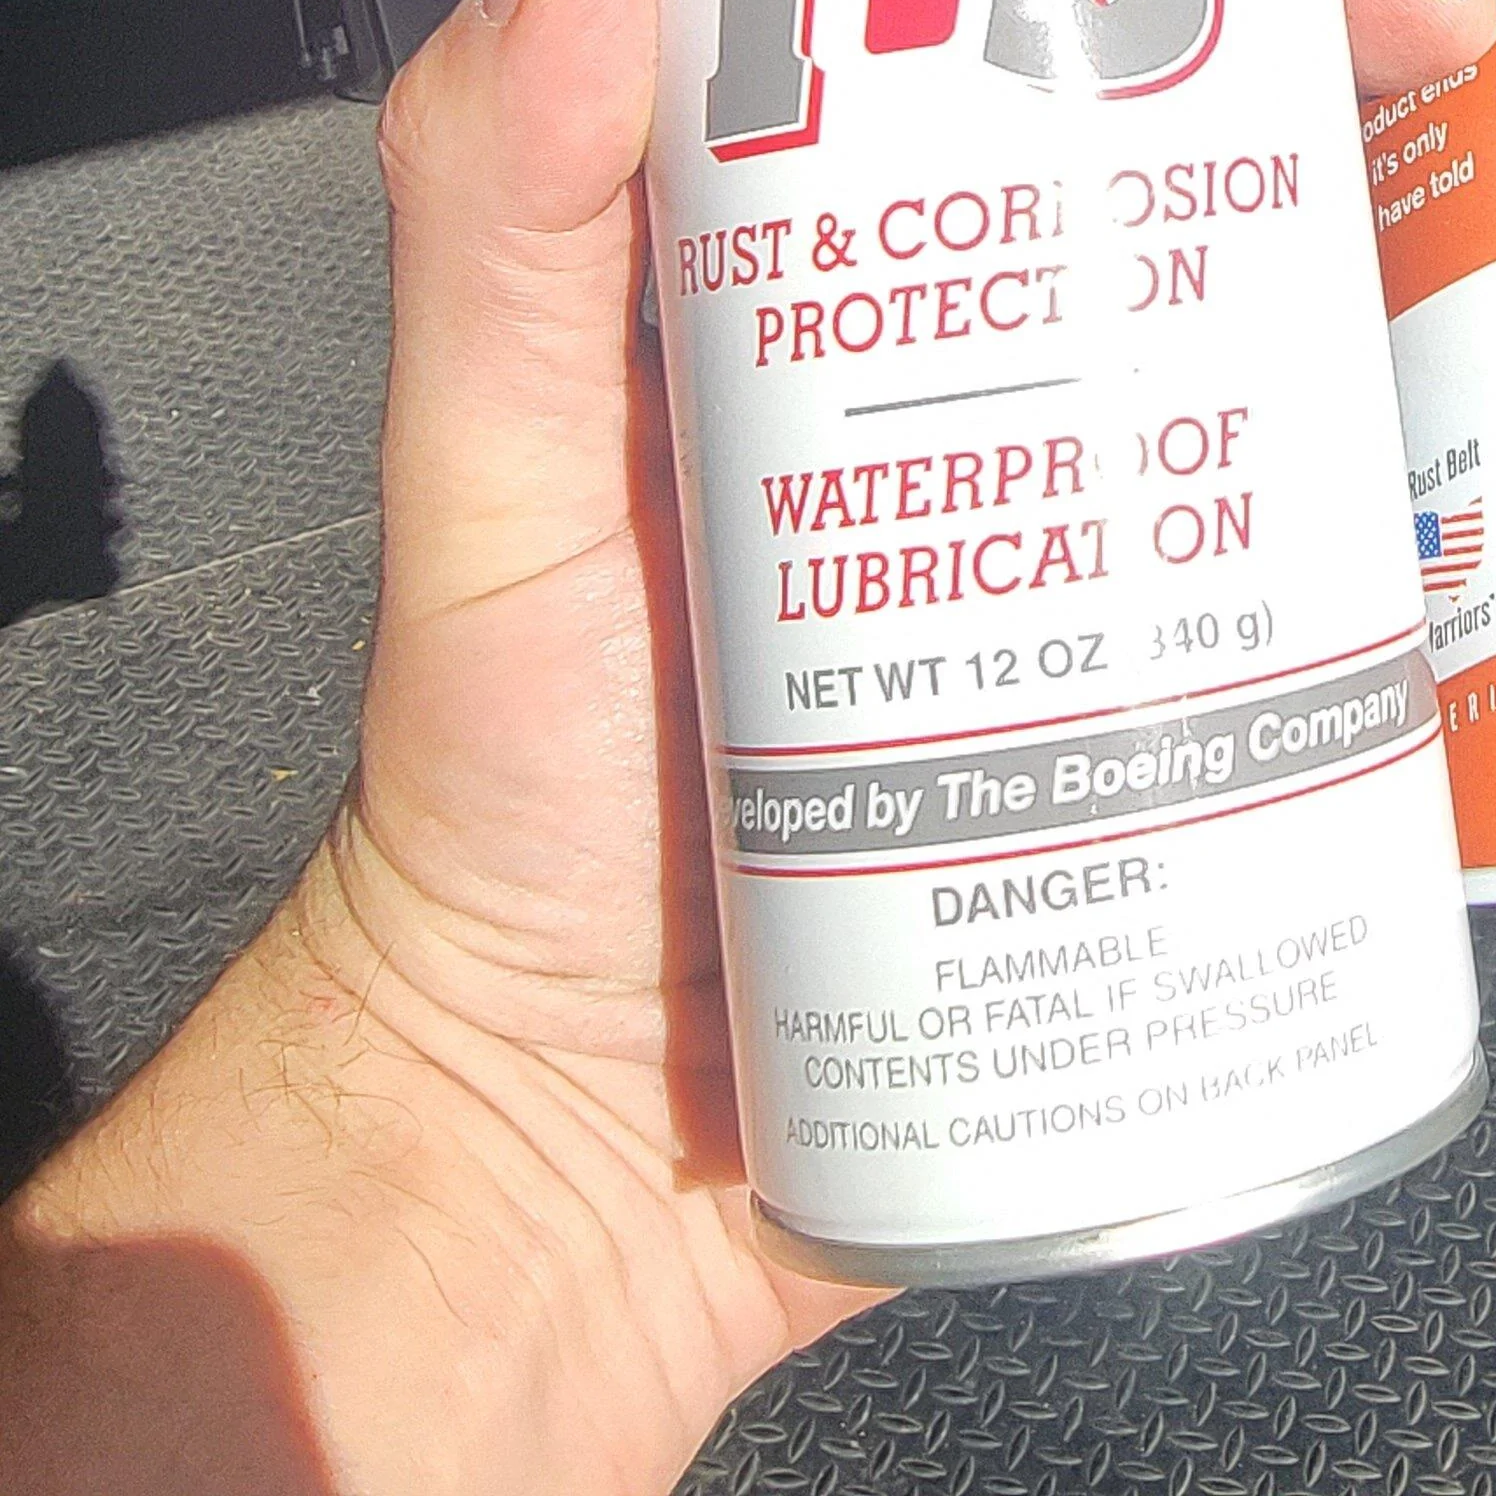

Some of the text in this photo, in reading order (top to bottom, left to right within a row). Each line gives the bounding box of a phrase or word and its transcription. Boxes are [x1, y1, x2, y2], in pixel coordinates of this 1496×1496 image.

[1378, 150, 1476, 233] have told
[1403, 120, 1448, 166] only
[676, 153, 1300, 297] RUST & COROSION
[754, 244, 1209, 369] PROTECTON
[761, 407, 1249, 537] WATERPROF
[1408, 437, 1481, 502] Rust Belt
[775, 491, 1254, 623] LUBRICATON
[785, 665, 864, 713] NET
[874, 656, 947, 703] WT
[966, 650, 1021, 688] 12
[1038, 631, 1108, 680] OZ
[1235, 599, 1274, 651] g)
[867, 780, 925, 836] by
[936, 767, 1037, 823] The
[1051, 727, 1237, 807] Boeing
[1246, 678, 1411, 764] Company
[931, 855, 1171, 929] DANGER:
[774, 914, 1369, 1043] HARMFUL OR FATAL IF SWALLOWED
[934, 926, 1170, 993] FLAMMABLE
[785, 1022, 1379, 1154] ADDITIONAL CAUTIONS ON BACK PANEL
[804, 971, 1340, 1091] CONTENTS UNDER PRESSURE
